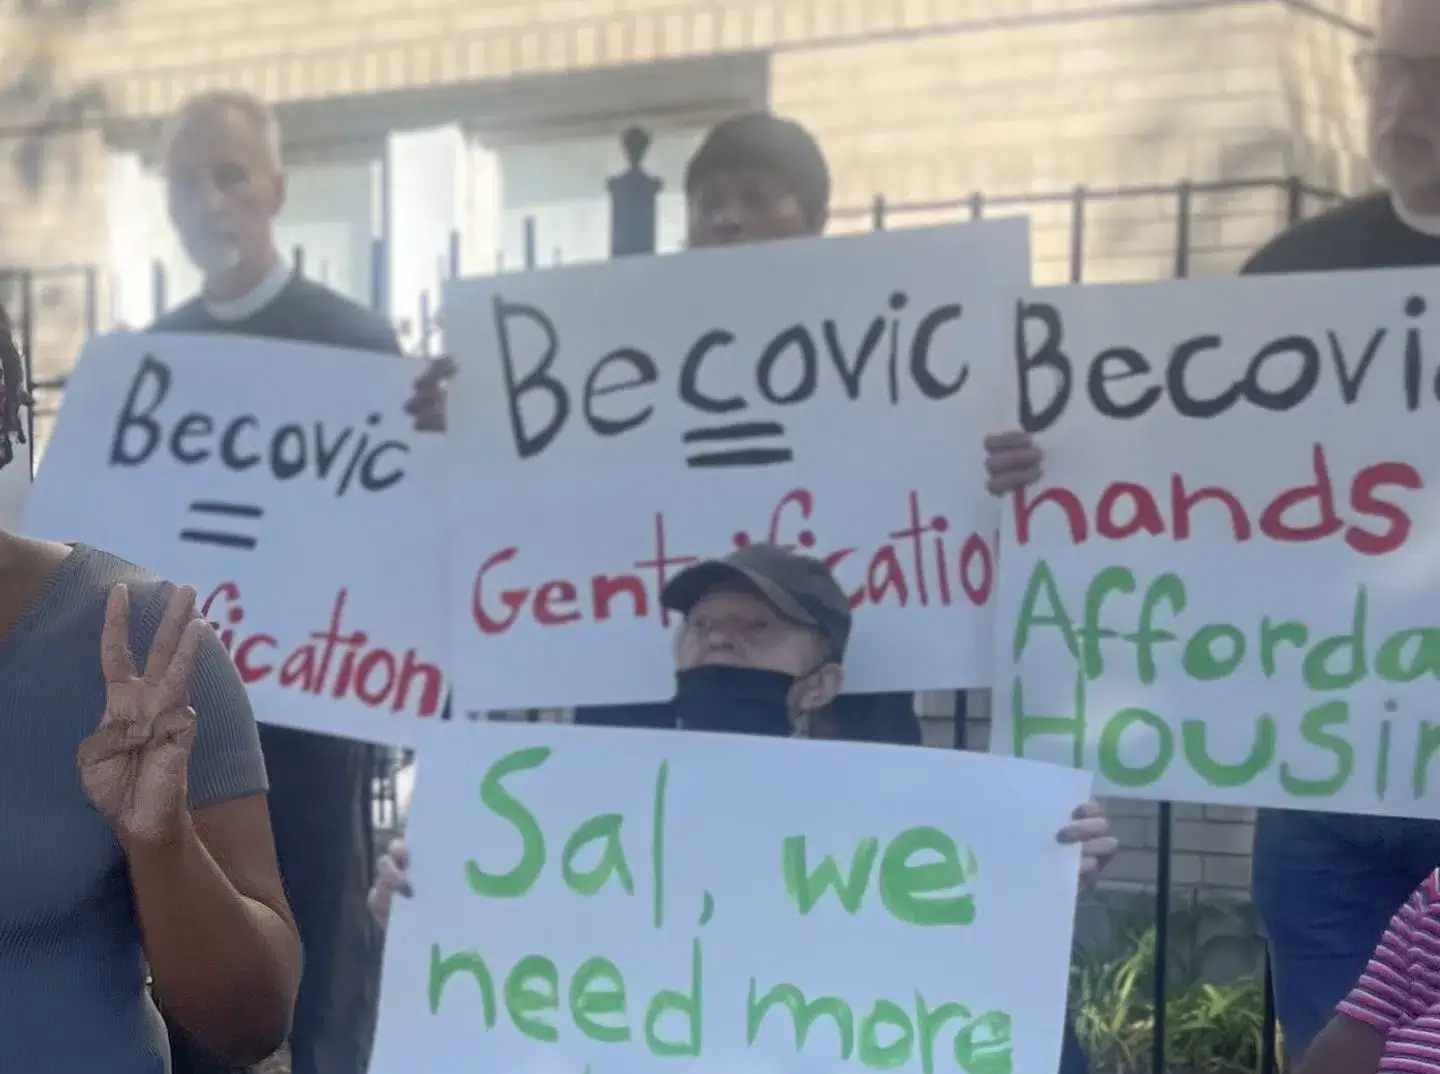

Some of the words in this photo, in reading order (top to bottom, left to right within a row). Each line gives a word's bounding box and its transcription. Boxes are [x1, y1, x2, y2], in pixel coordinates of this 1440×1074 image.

[108, 354, 412, 497] Becovic
[493, 291, 969, 459] Becovic
[1014, 294, 1440, 433] Becovi
[1014, 442, 1423, 556] hands
[465, 745, 715, 929] Sal,
[781, 825, 978, 926] we
[428, 936, 704, 1058] need
